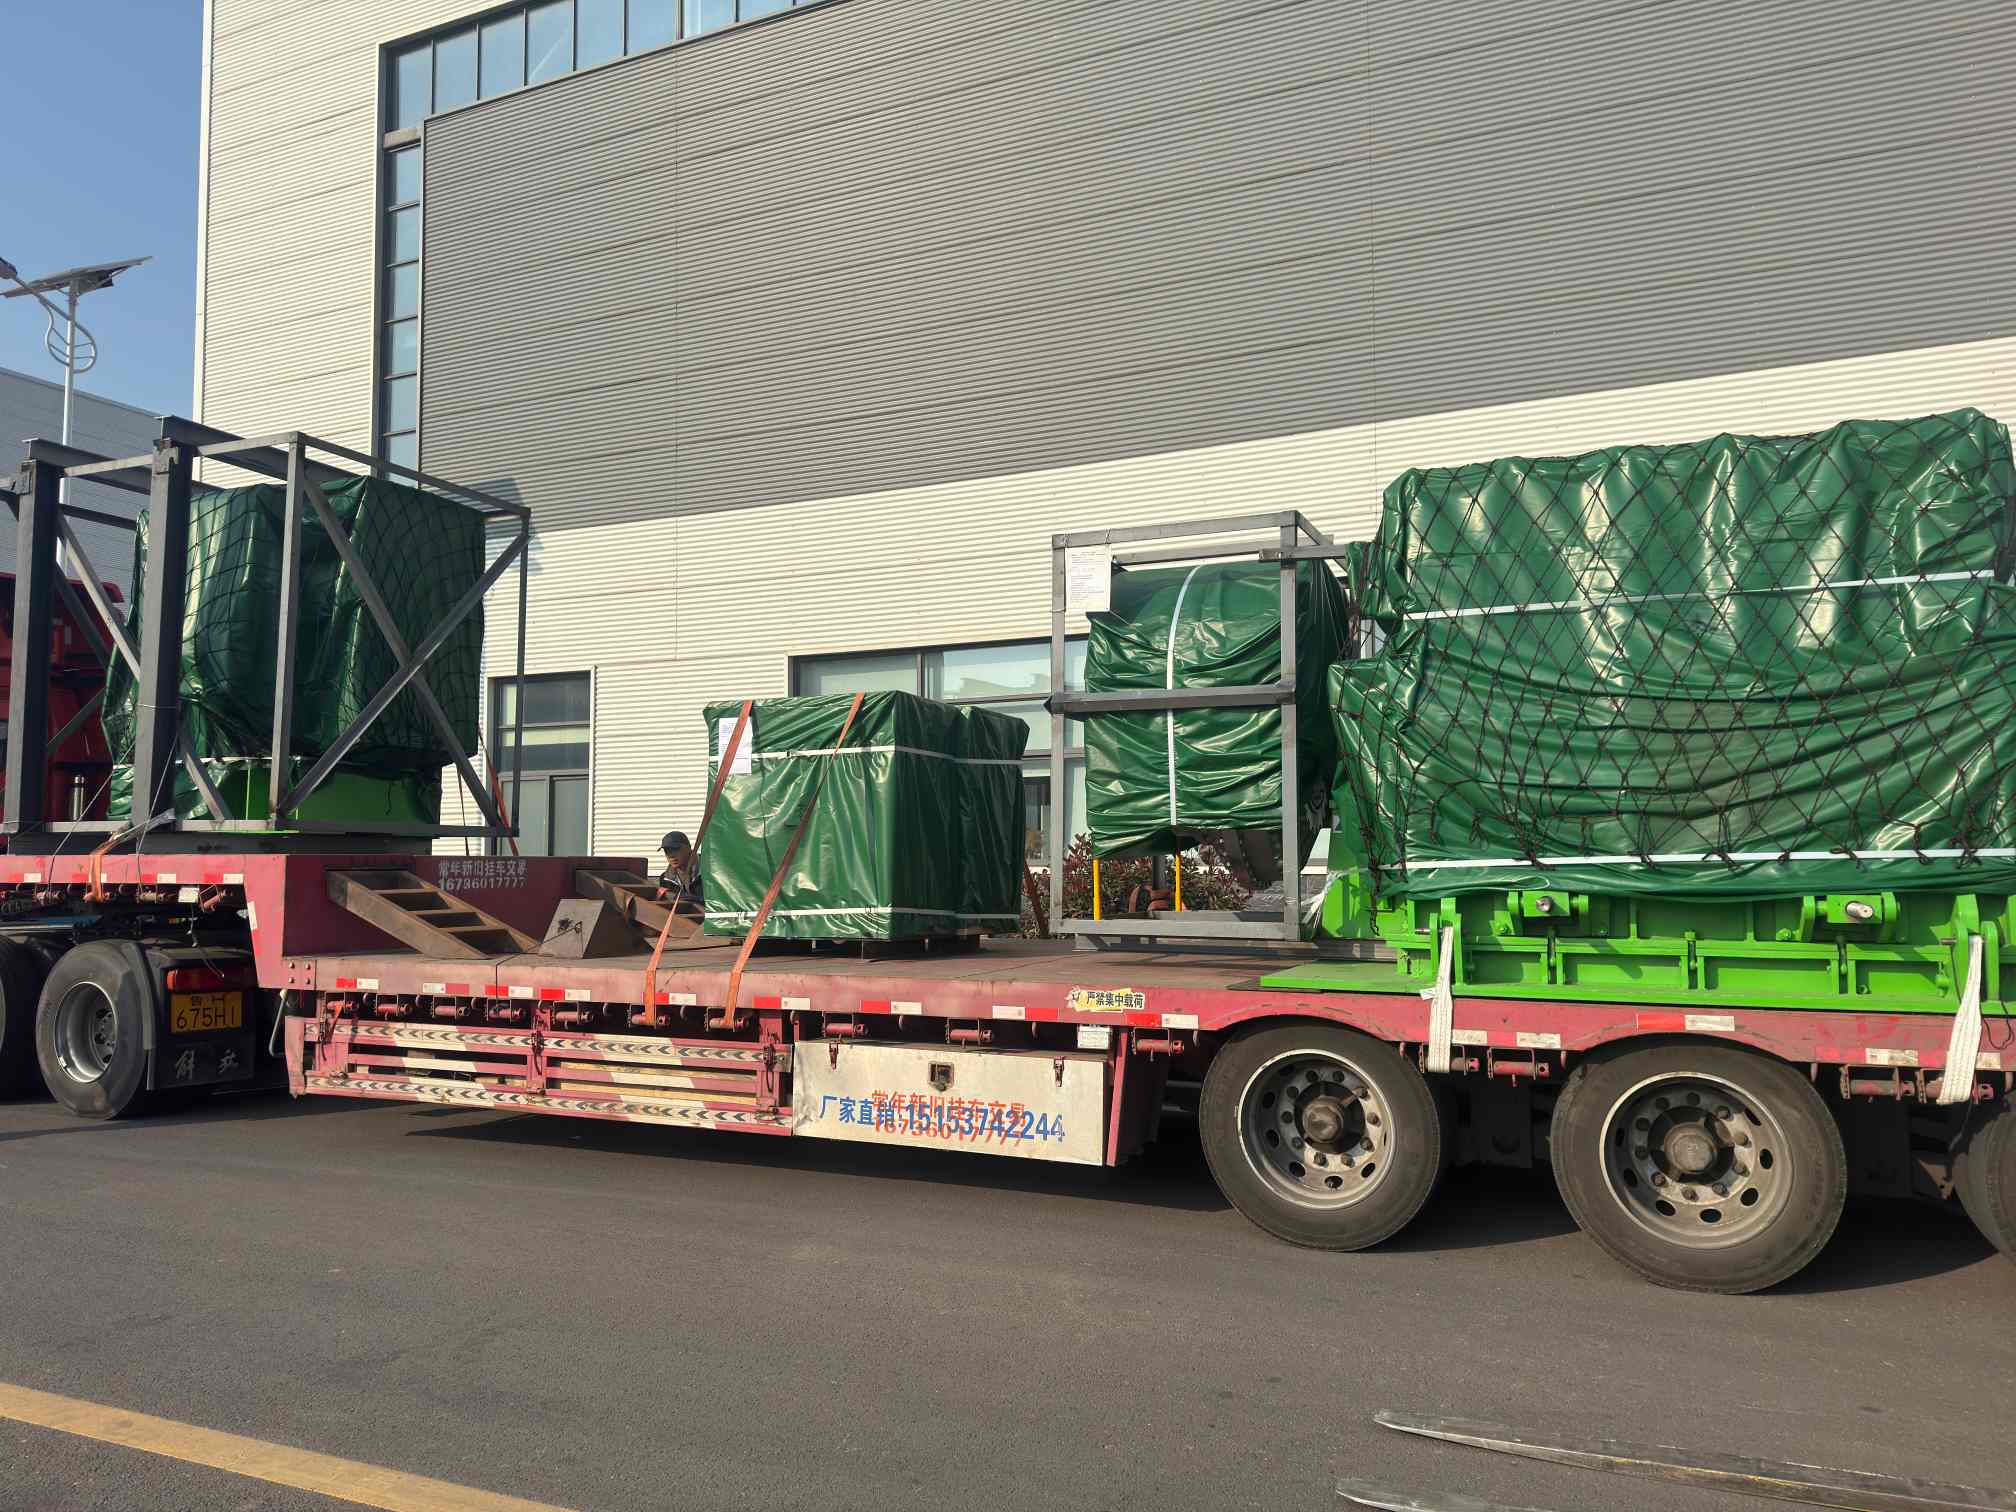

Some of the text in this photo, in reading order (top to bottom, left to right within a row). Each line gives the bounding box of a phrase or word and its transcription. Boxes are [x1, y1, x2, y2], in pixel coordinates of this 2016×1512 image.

[1086, 991, 1144, 1009] 严禁集中载荷
